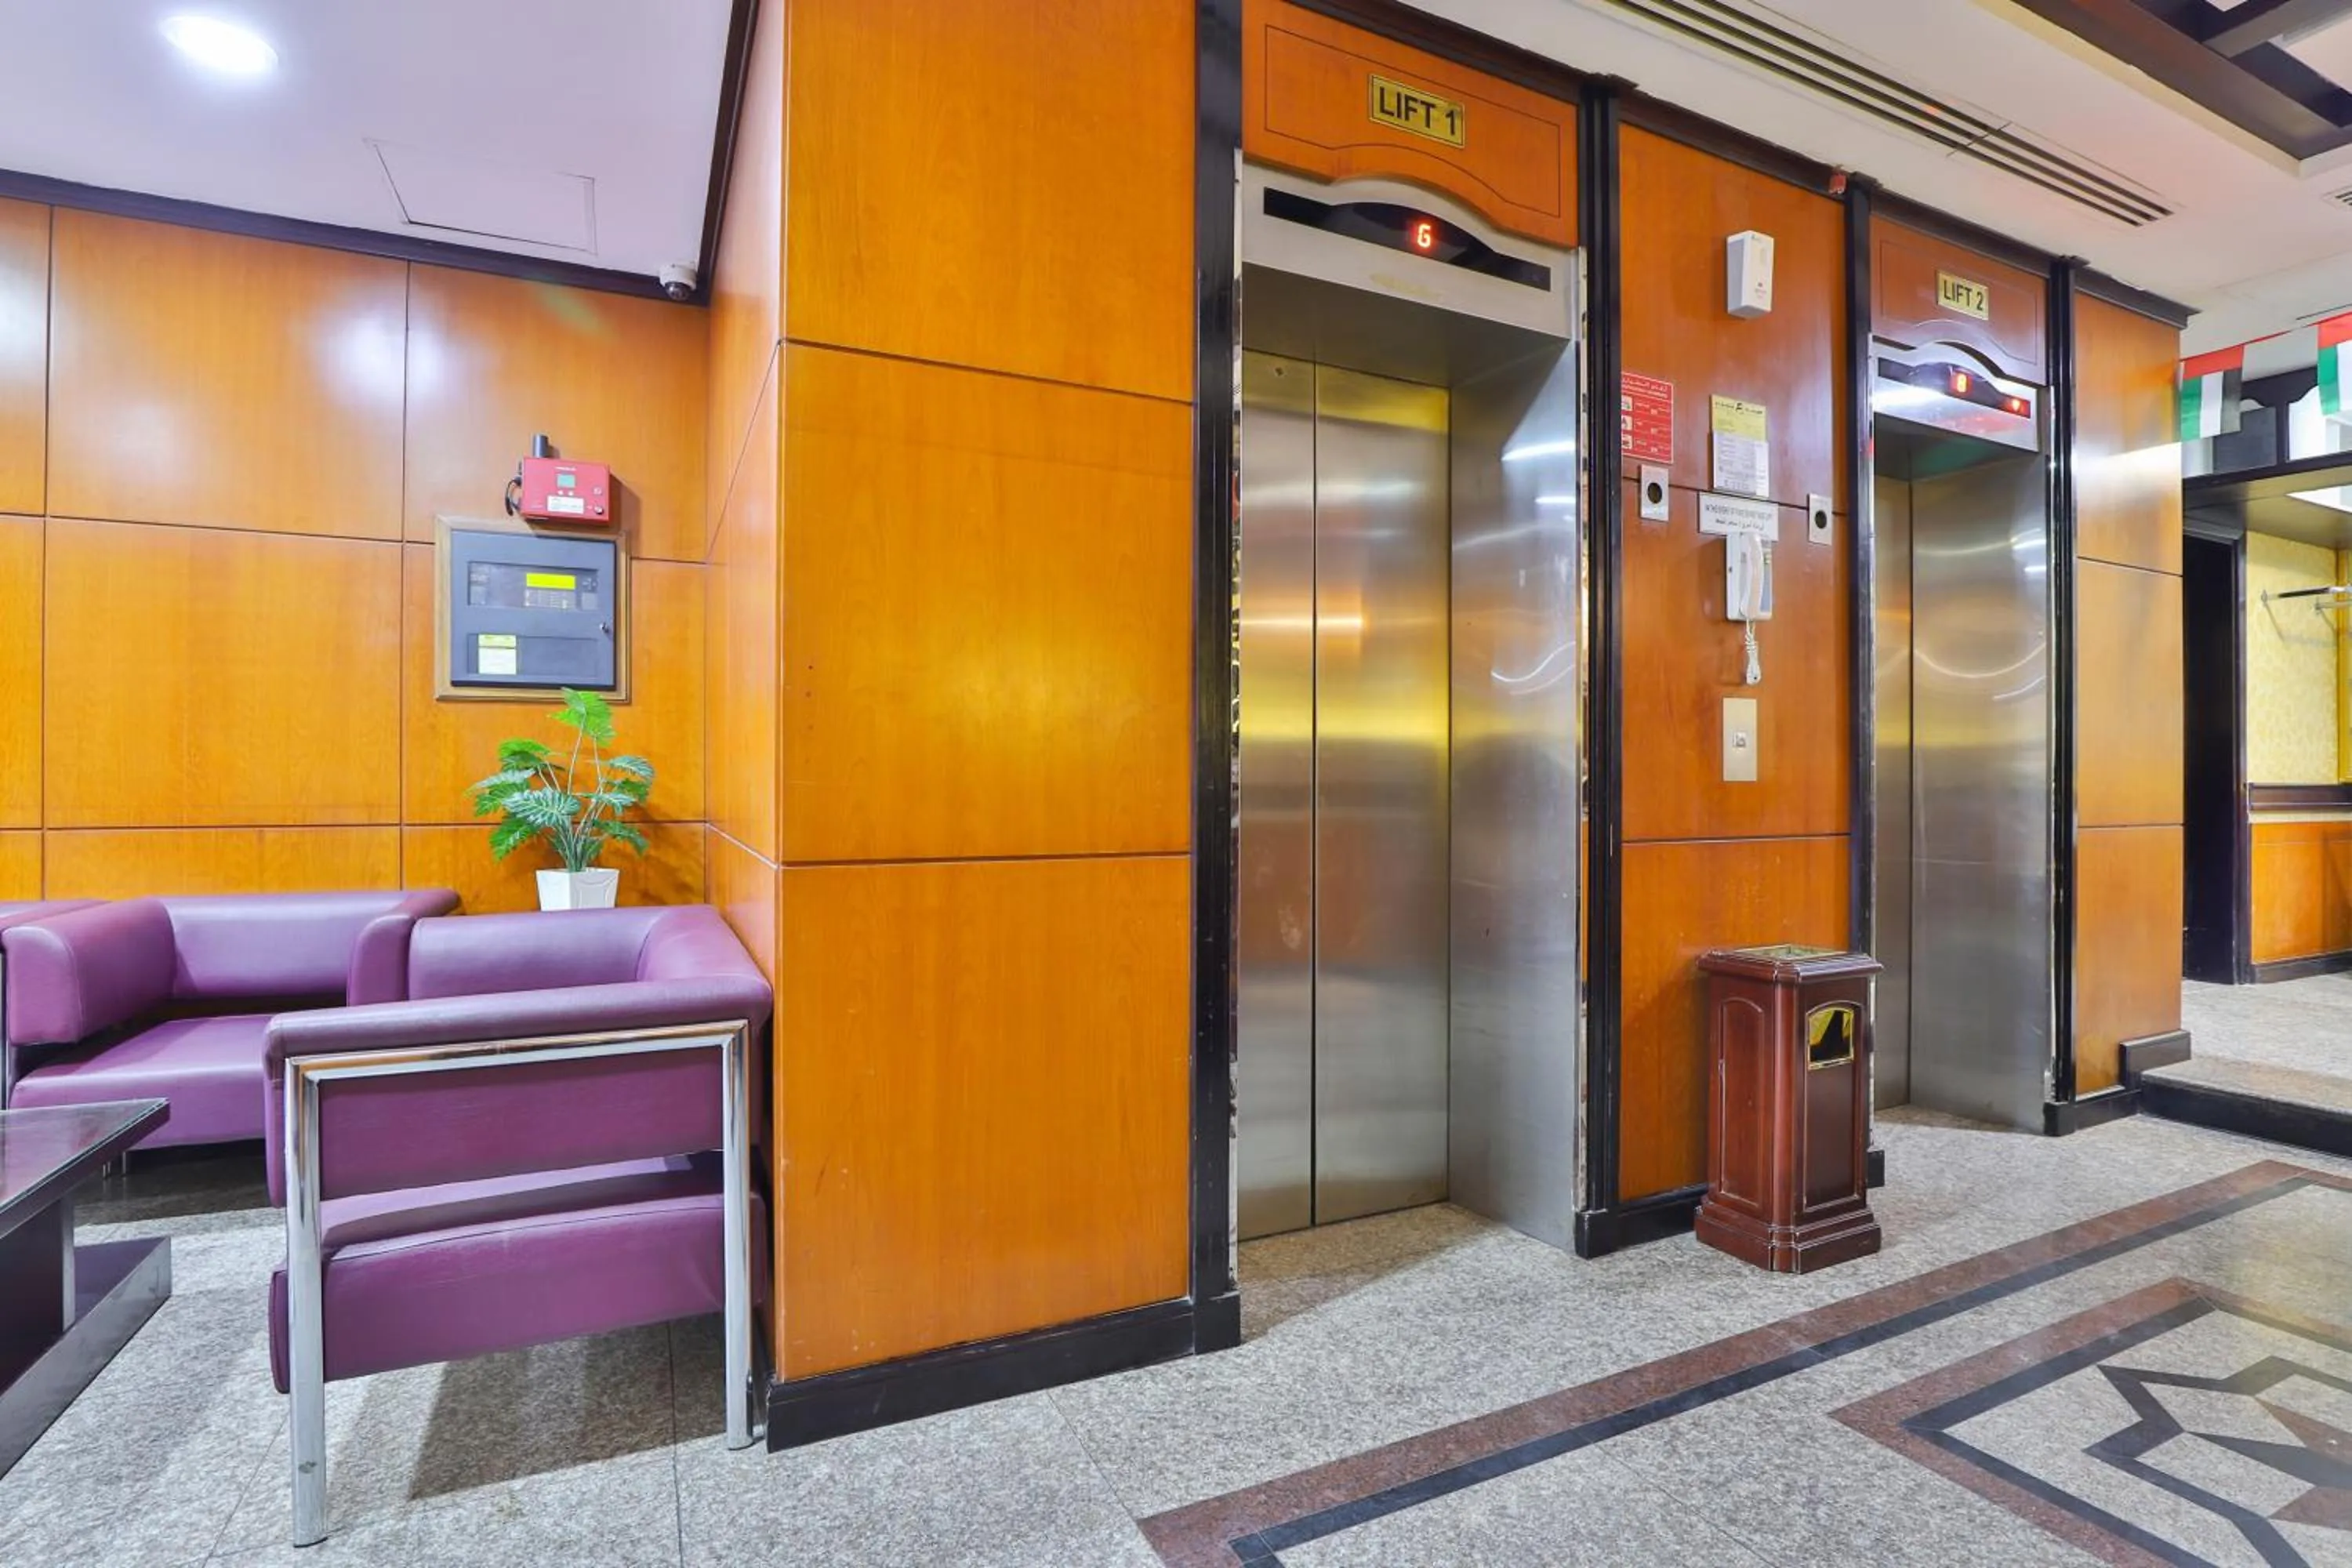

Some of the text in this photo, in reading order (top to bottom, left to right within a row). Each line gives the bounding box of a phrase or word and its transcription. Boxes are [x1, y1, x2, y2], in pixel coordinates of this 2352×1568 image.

[1379, 86, 1455, 136] LIFT 1
[1944, 279, 1984, 311] LIFT 2
